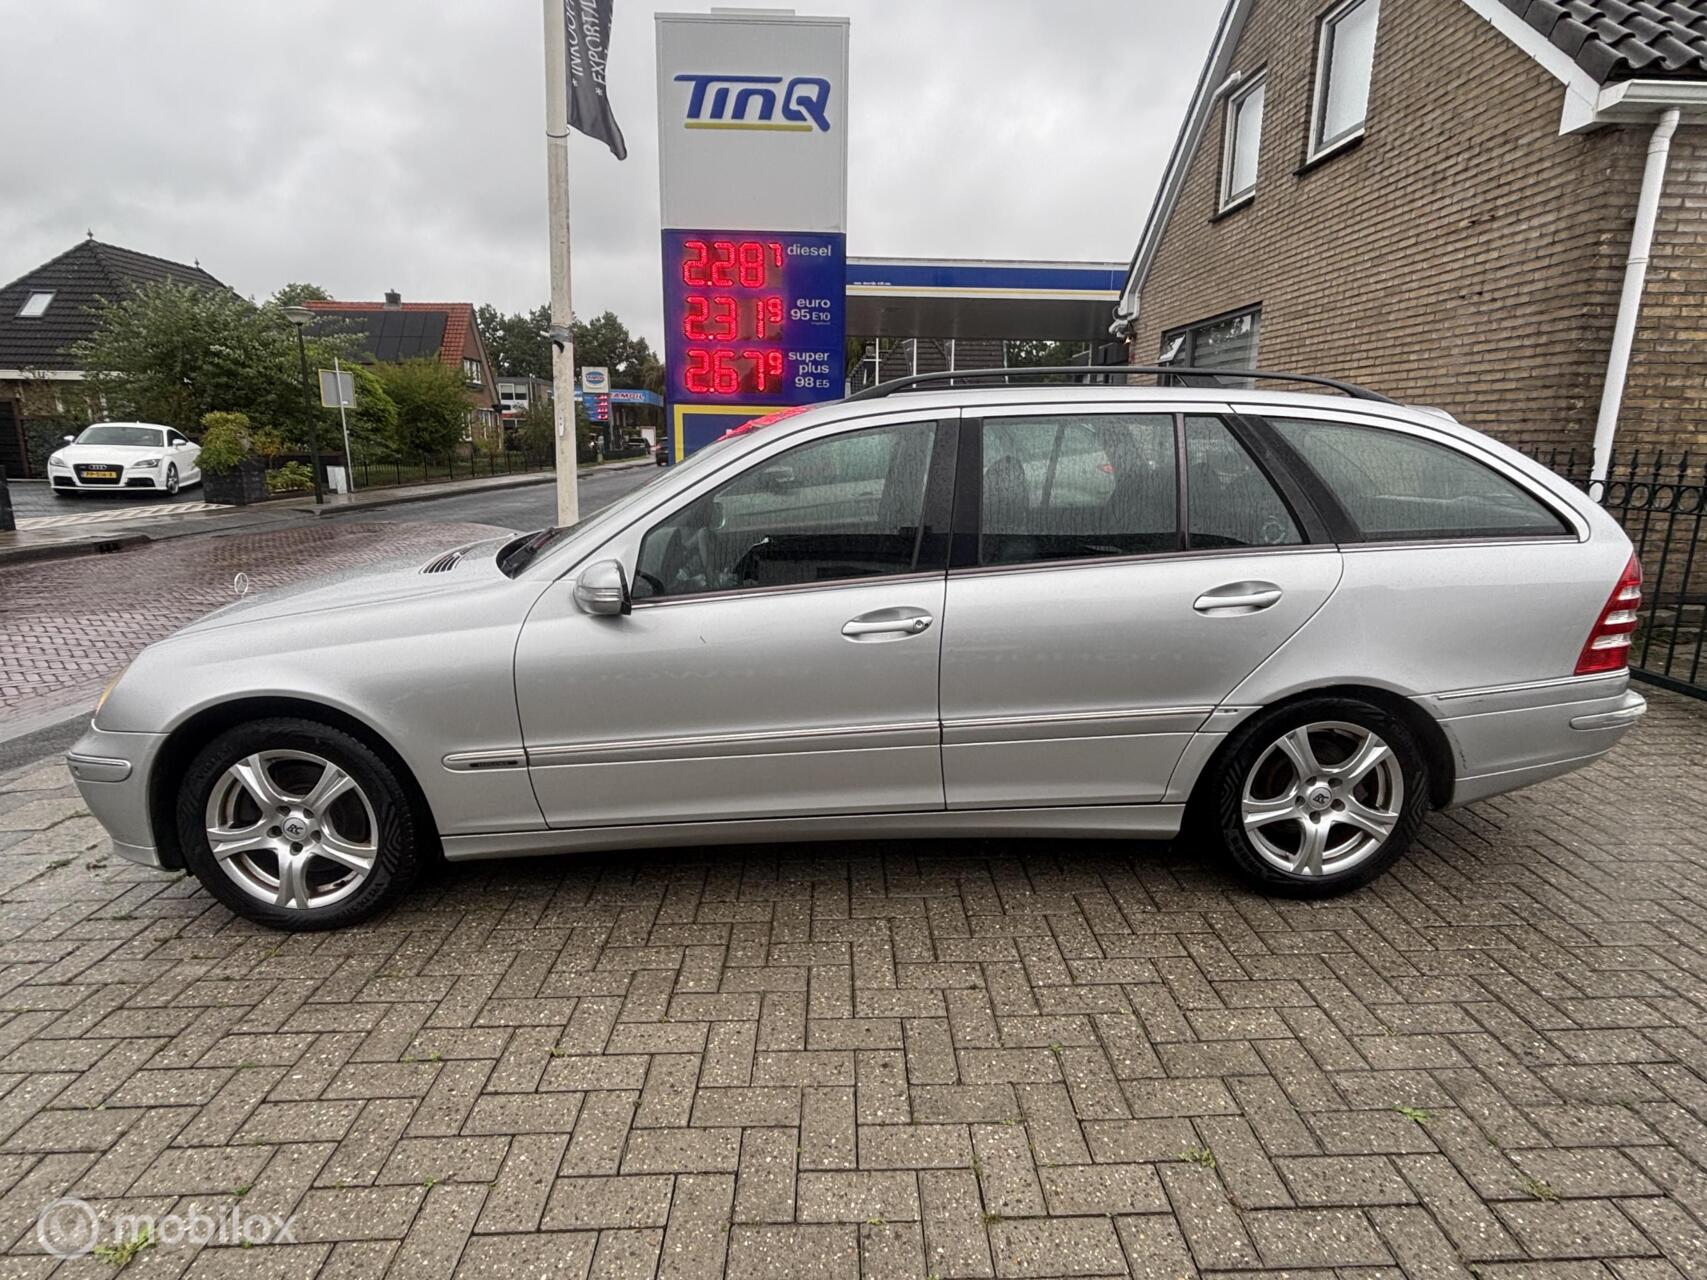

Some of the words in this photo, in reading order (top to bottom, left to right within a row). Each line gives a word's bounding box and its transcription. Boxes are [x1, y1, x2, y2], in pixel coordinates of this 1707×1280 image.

[787, 244, 832, 257] diesel
[796, 298, 831, 308] euro
[790, 308, 810, 321] 95
[812, 311, 831, 321] E10
[788, 351, 830, 364] super
[799, 362, 830, 375] plus
[794, 376, 814, 388] 98
[816, 379, 830, 388] E5
